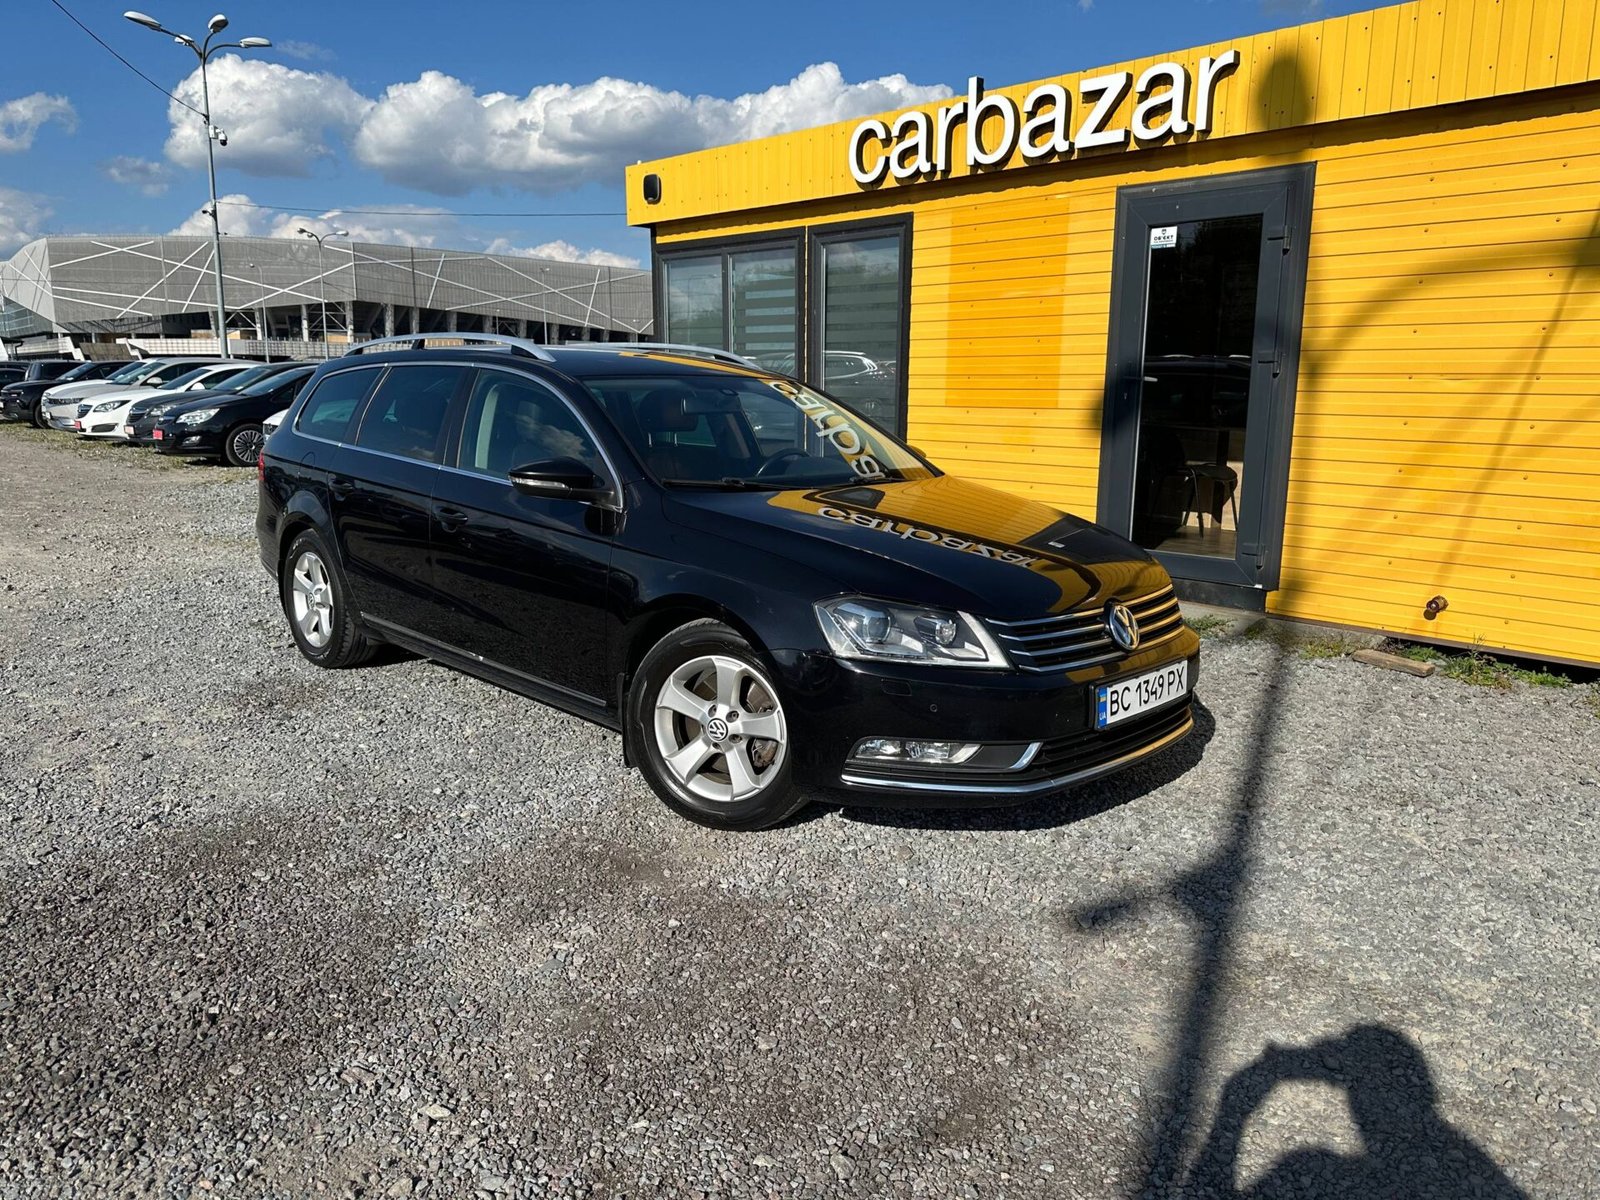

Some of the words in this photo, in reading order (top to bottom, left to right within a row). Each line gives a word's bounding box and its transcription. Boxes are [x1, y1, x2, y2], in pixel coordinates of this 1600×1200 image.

[848, 49, 1239, 184] carbazar
[1109, 685, 1132, 717] BC
[1135, 673, 1165, 707] 1349
[1167, 665, 1185, 697] PX
